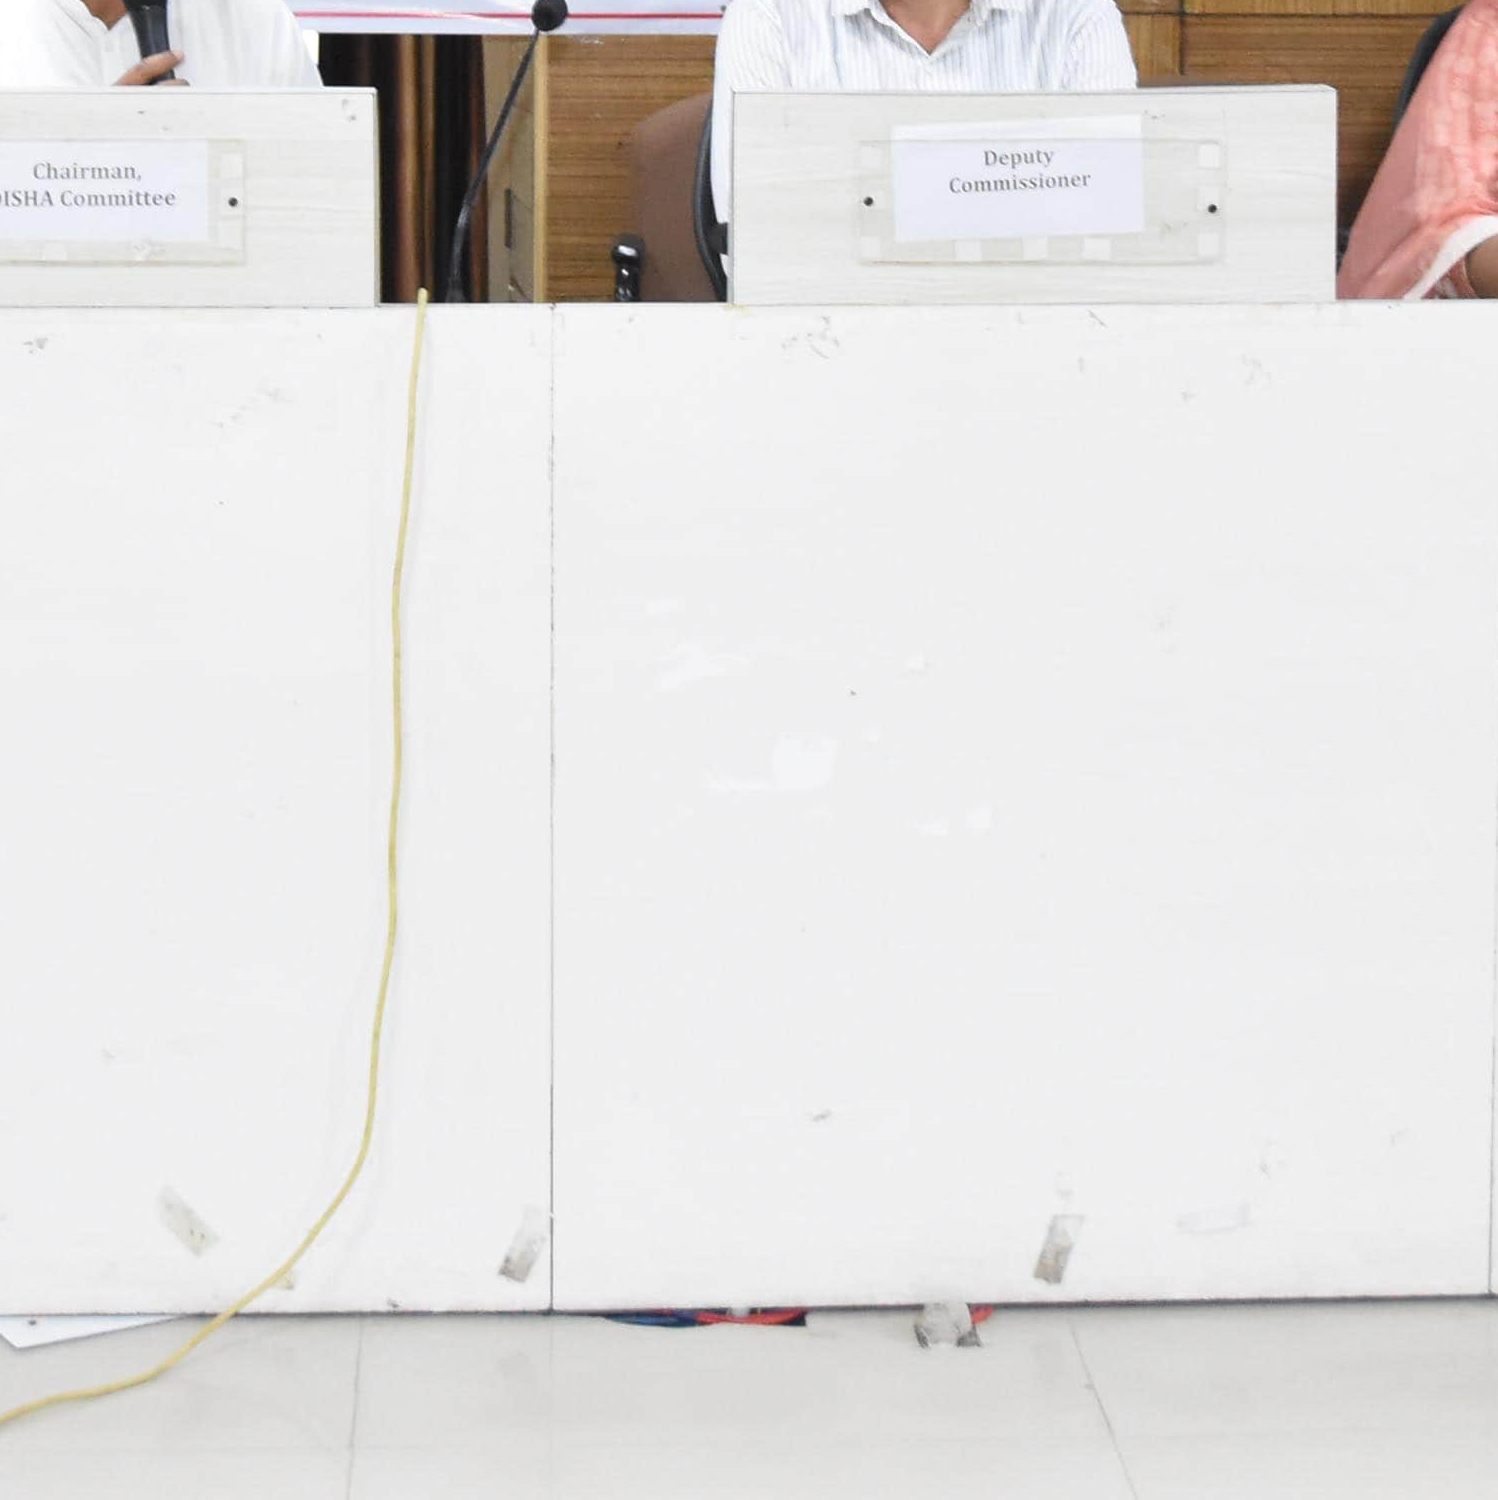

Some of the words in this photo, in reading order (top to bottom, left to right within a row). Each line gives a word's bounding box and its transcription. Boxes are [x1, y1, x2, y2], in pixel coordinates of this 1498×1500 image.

[983, 148, 1055, 170] Deputy
[31, 161, 143, 182] Chairman,
[948, 172, 1093, 195] Commissioner
[59, 189, 177, 208] Committee
